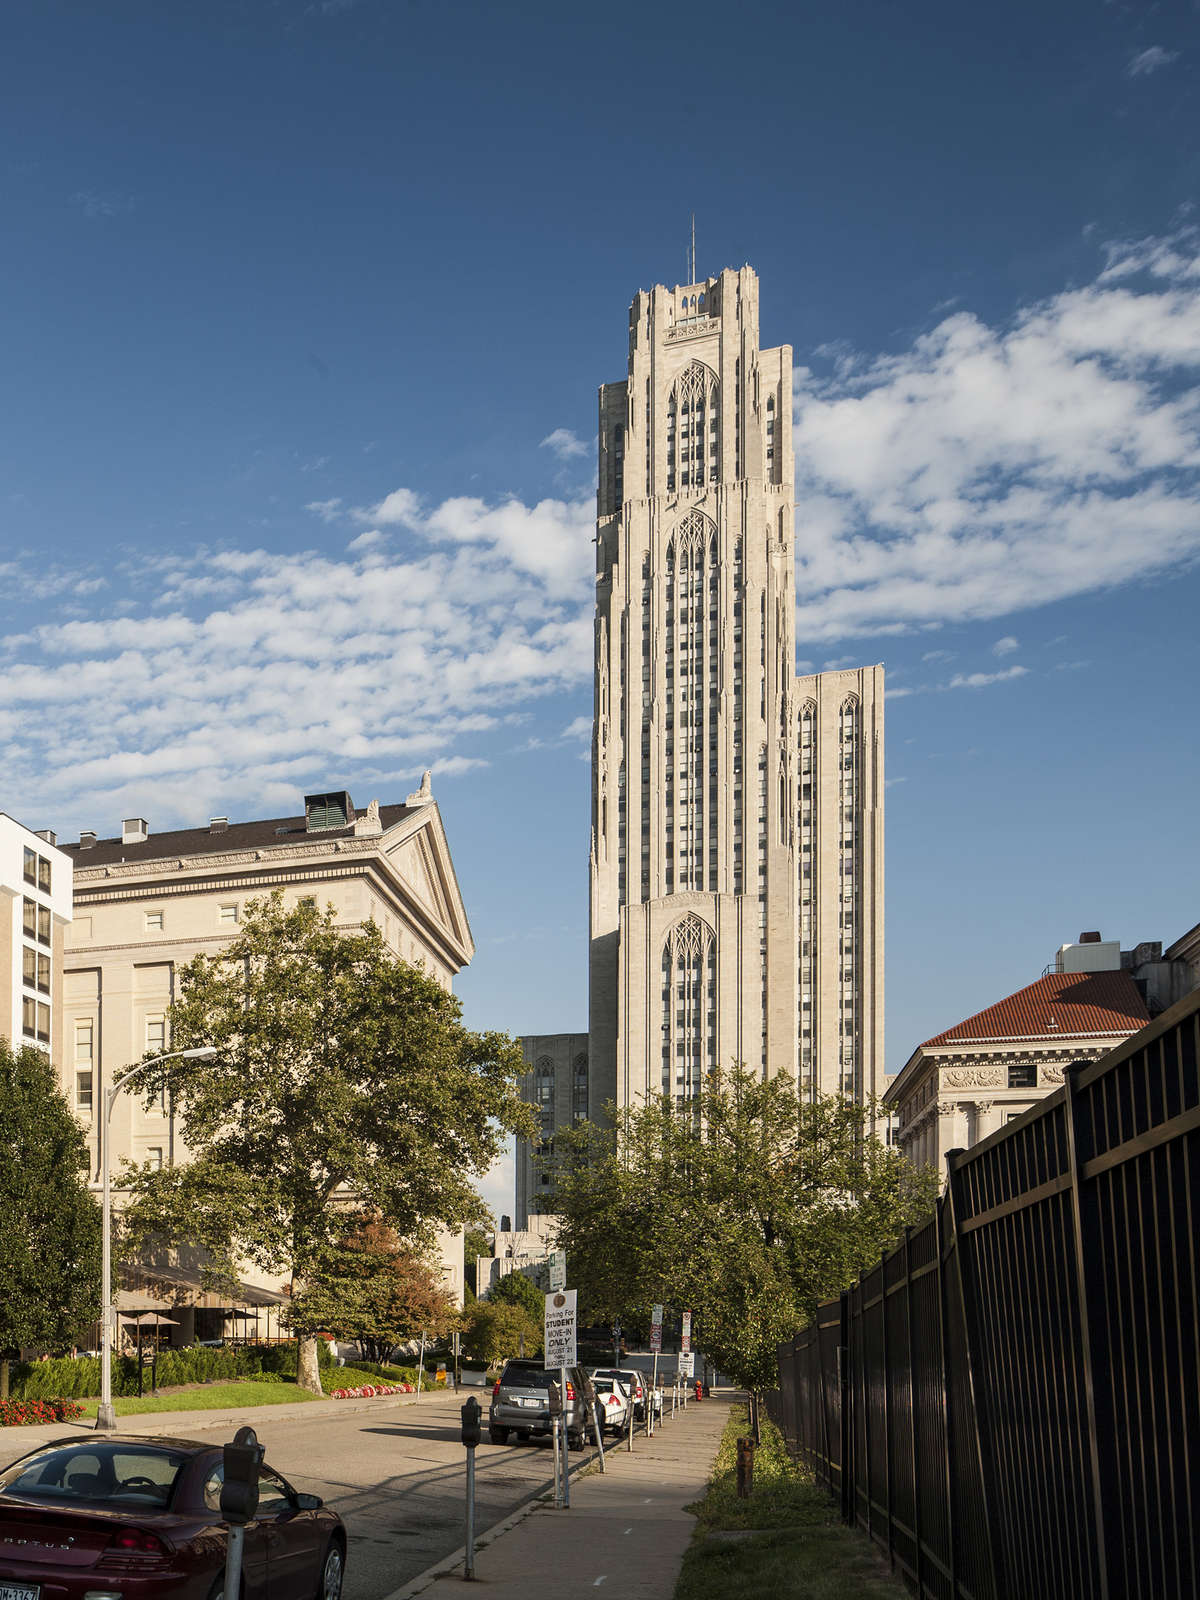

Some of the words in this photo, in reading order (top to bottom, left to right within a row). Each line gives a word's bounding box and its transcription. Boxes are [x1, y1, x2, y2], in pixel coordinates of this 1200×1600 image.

[546, 1318, 574, 1328] STUDENT
[548, 1328, 572, 1338] MOVE-IN
[548, 1337, 570, 1347] ONLY
